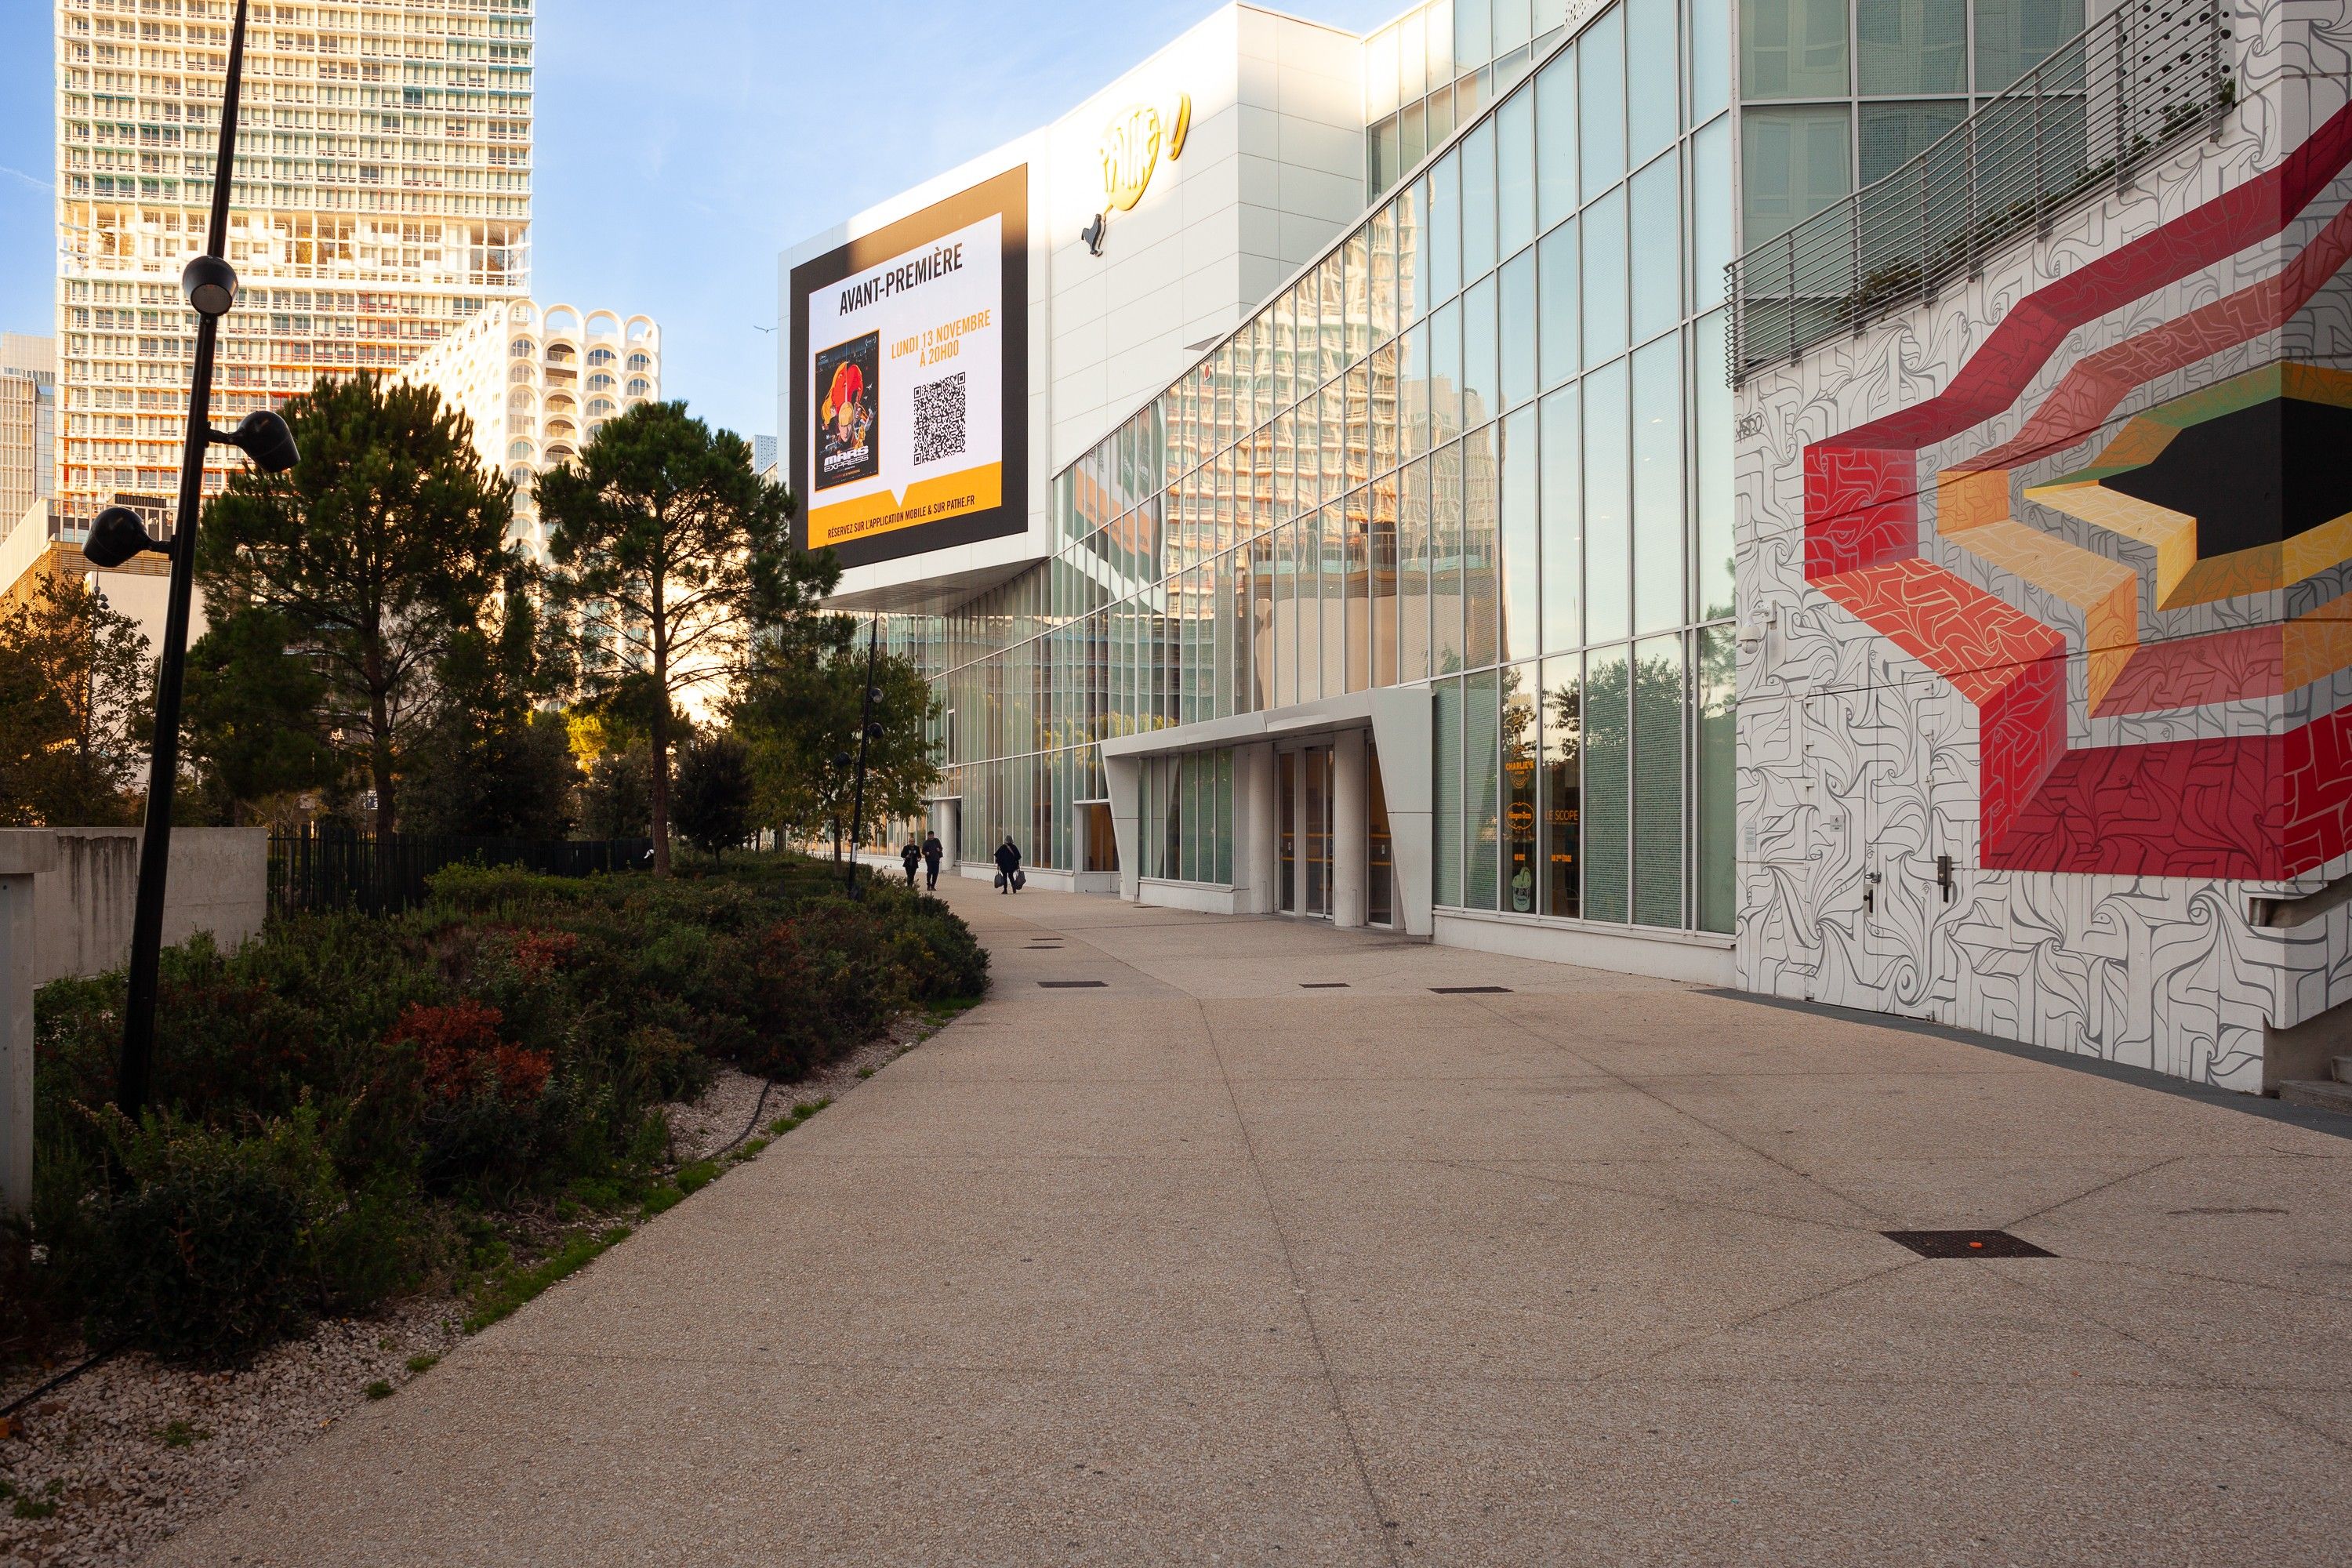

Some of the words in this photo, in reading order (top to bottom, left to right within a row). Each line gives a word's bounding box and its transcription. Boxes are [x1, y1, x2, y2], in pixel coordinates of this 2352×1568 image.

[840, 242, 963, 316] AVANT-PREMIÈRE
[891, 335, 918, 359] LUNDI
[922, 330, 933, 347] 13
[936, 309, 991, 343] NOVEMBRE
[920, 348, 926, 368] À
[928, 339, 959, 365] 20H00
[824, 445, 869, 466] MARS
[824, 454, 869, 473] EXPRESS
[827, 524, 853, 539] RÉSERVEZ
[854, 521, 865, 532] SUR
[866, 511, 904, 530] L'APPLICATION
[905, 506, 926, 521] MOBILE
[927, 504, 932, 515] &
[933, 502, 946, 514] SUR
[946, 495, 975, 511] PATHE.FR
[1555, 810, 1579, 821] SCOPE
